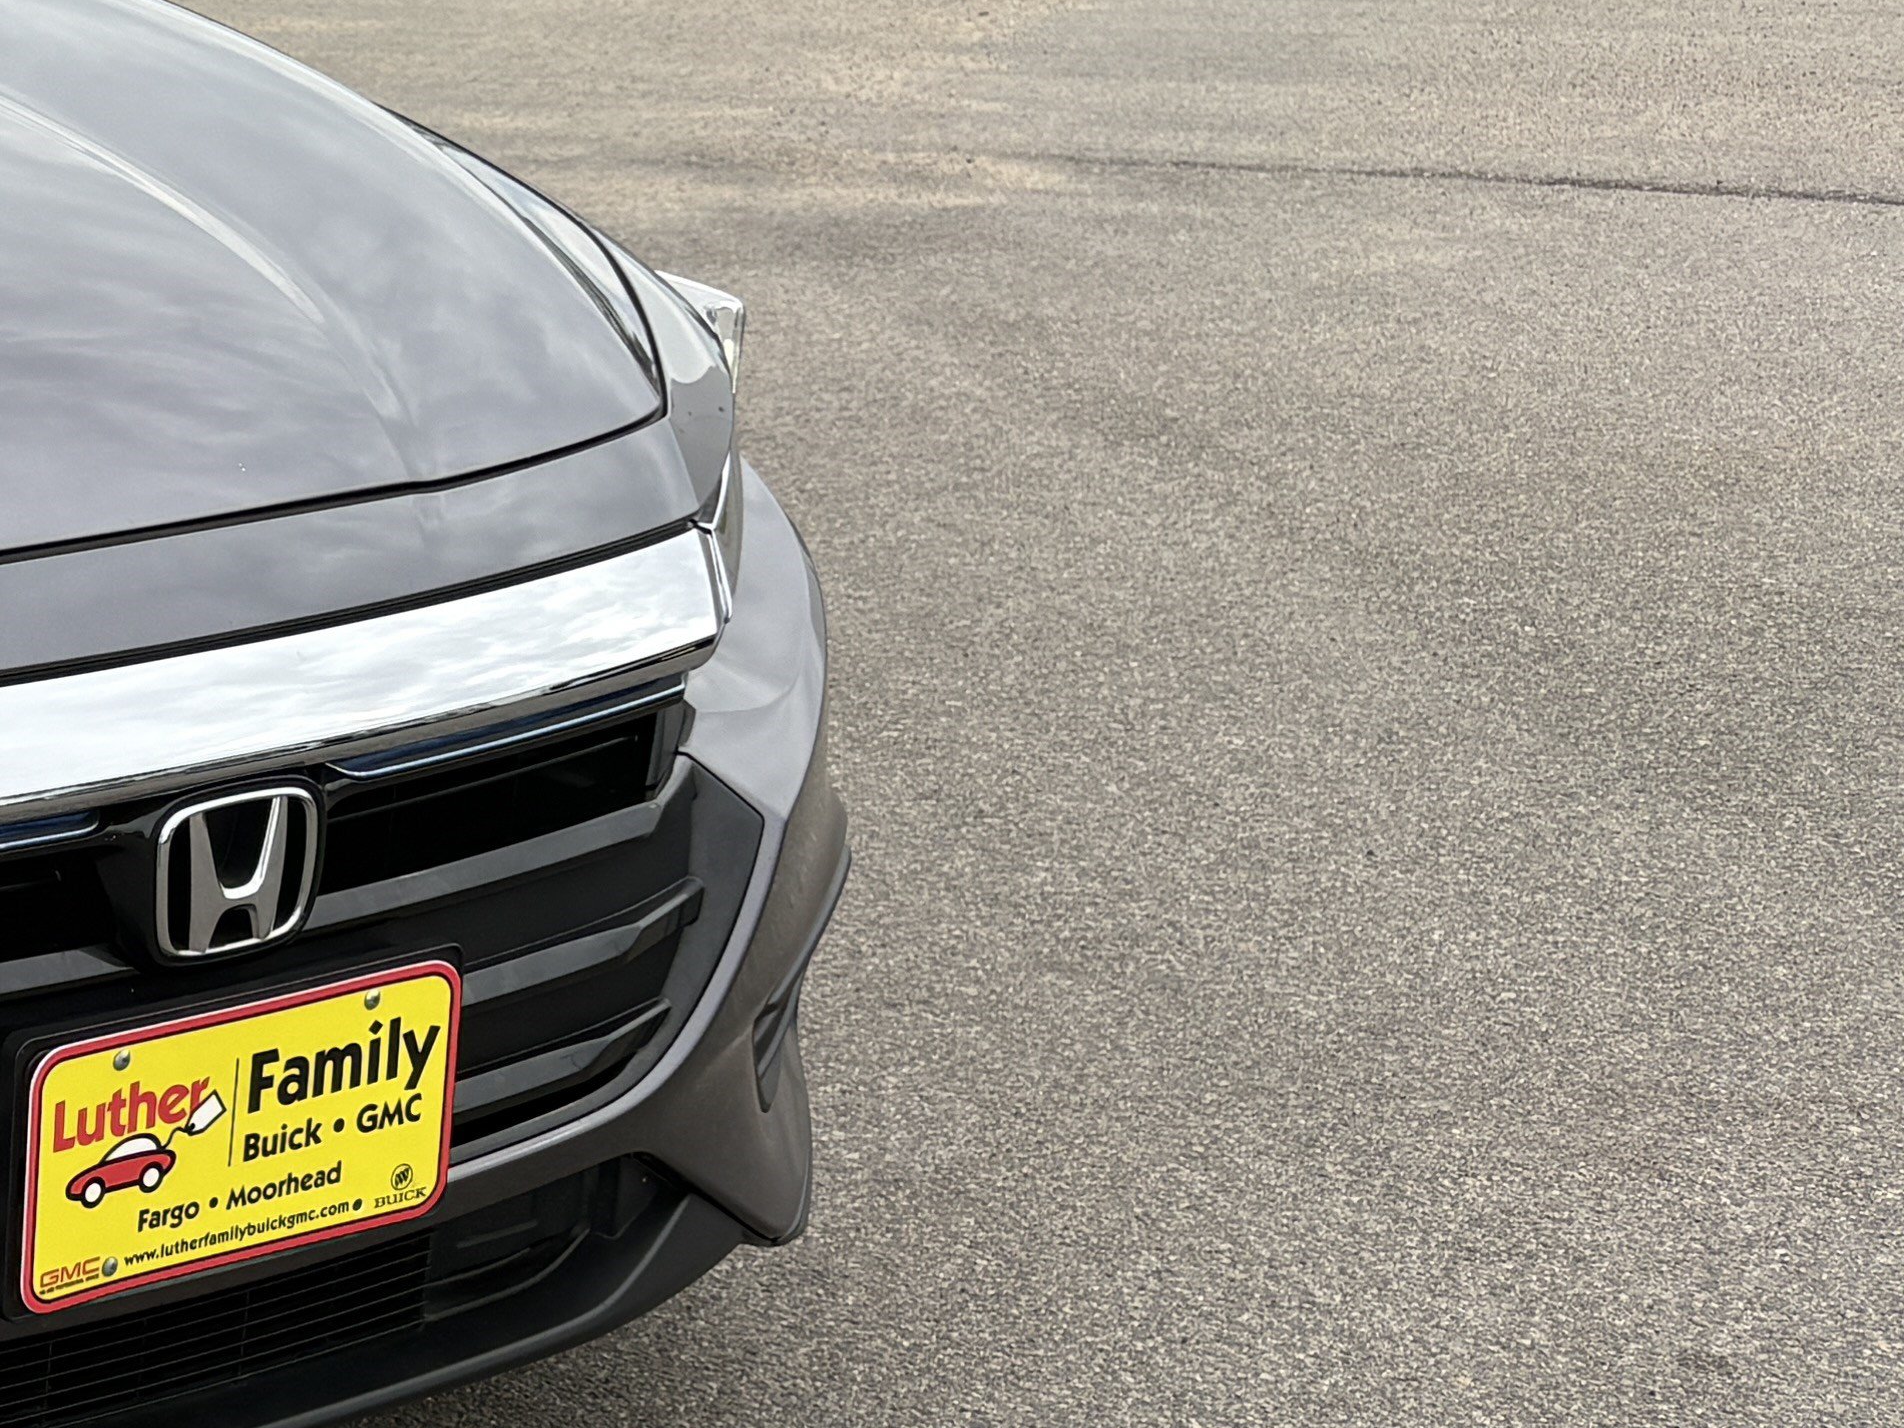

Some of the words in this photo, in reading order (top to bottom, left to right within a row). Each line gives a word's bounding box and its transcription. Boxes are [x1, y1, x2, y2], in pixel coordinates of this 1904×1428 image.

[247, 1016, 441, 1114] Family
[53, 1076, 210, 1153] Luther
[243, 1117, 322, 1162] Buick
[356, 1093, 422, 1133] GMC
[137, 1201, 200, 1232] Fargo
[225, 1160, 342, 1210] Moorhead
[374, 1186, 427, 1209] BUICK
[124, 1201, 350, 1266] www.lutherfamilybuickgmc.com
[39, 1256, 101, 1288] GMC
